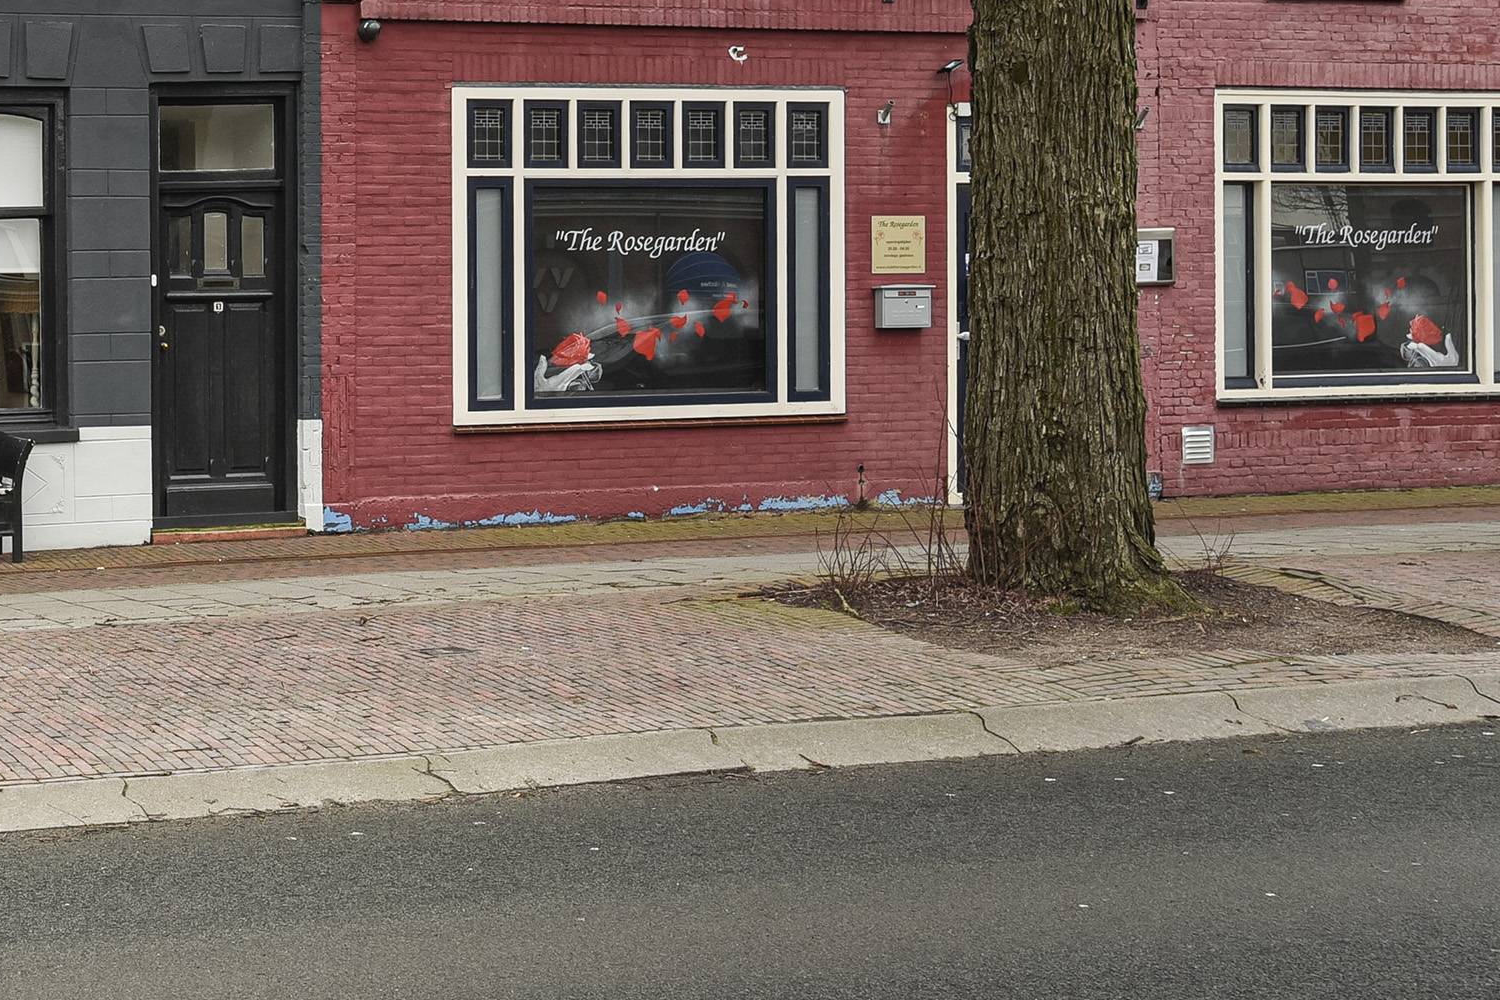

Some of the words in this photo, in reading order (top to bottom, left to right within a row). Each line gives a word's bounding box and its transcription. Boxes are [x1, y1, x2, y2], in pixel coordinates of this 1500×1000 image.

[555, 227, 603, 252] "The
[606, 228, 726, 259] Rosegarden"
[1294, 222, 1336, 245] "The
[1339, 222, 1439, 251] Rosegarden"
